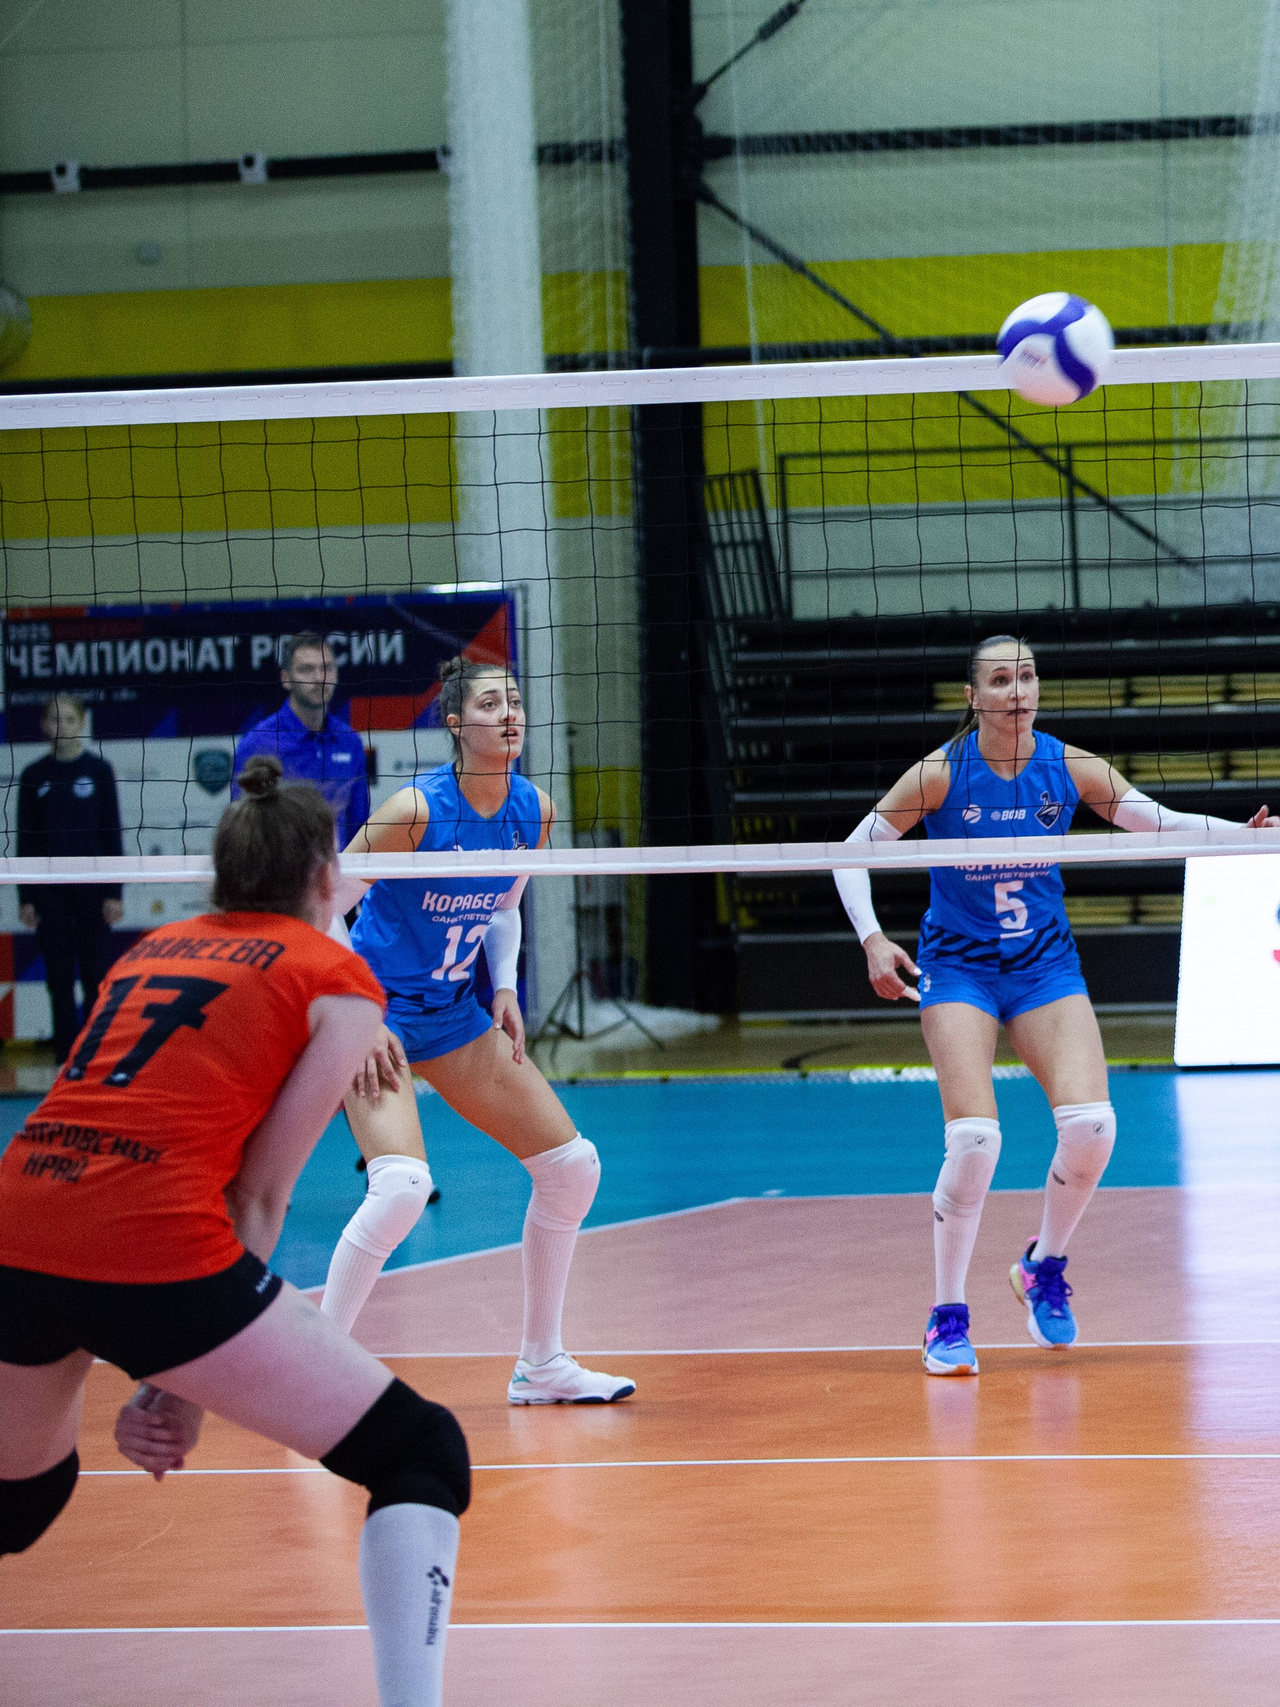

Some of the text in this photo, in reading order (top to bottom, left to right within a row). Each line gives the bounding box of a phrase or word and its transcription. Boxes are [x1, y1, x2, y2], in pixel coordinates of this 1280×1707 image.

[7, 629, 405, 679] ЧЕМПИОНАТ РСИИ
[993, 880, 1029, 930] 5
[430, 924, 487, 982] 12
[65, 974, 230, 1088] 17
